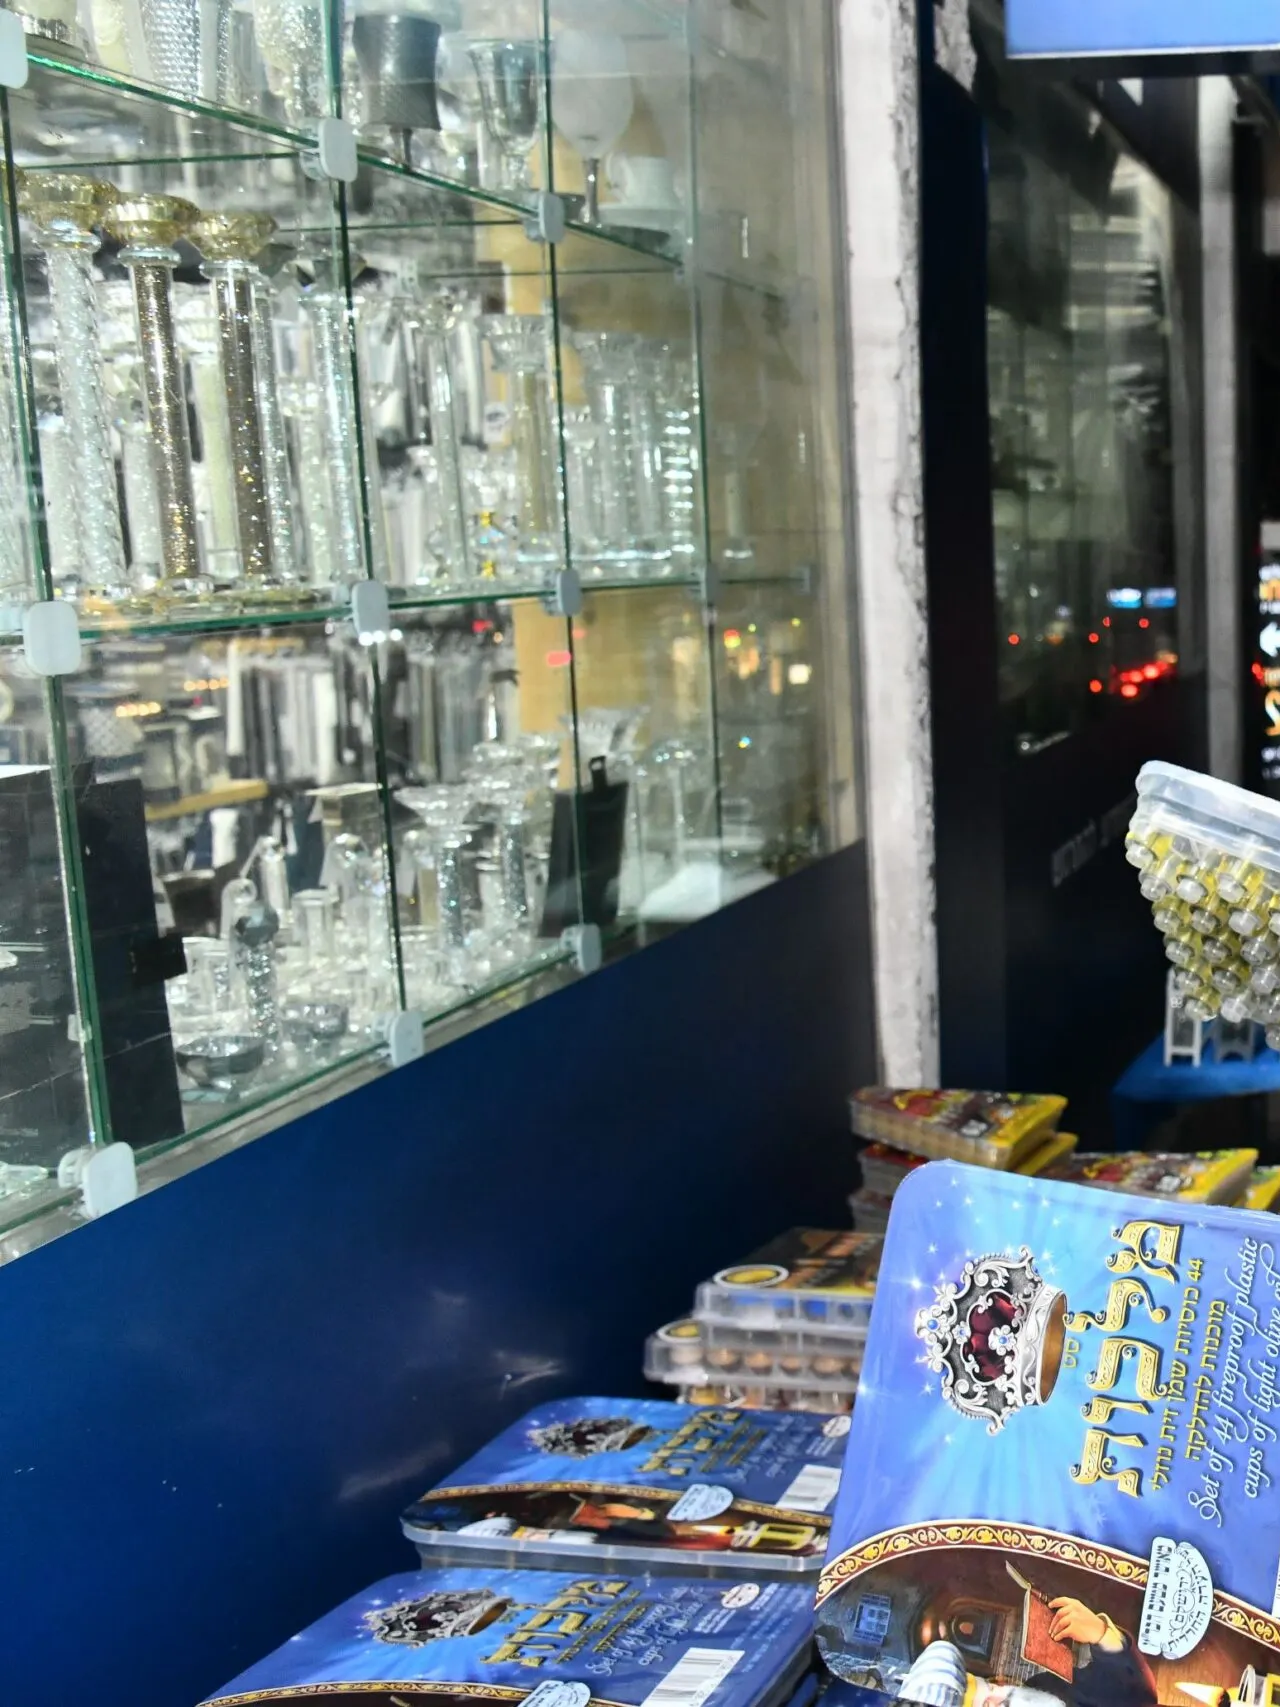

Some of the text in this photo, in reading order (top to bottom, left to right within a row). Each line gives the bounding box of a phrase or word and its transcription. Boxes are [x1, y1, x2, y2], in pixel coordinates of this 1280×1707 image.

[1063, 1220, 1182, 1497] מלכות
[1150, 1258, 1203, 1490] 44 כוסיות שמן זית נוזלי
[1184, 1299, 1226, 1461] מוכנות להדלקה
[1187, 1238, 1258, 1527] Set of 44 fireproof plastic
[1246, 1409, 1277, 1442] of
[1244, 1447, 1269, 1497] cups
